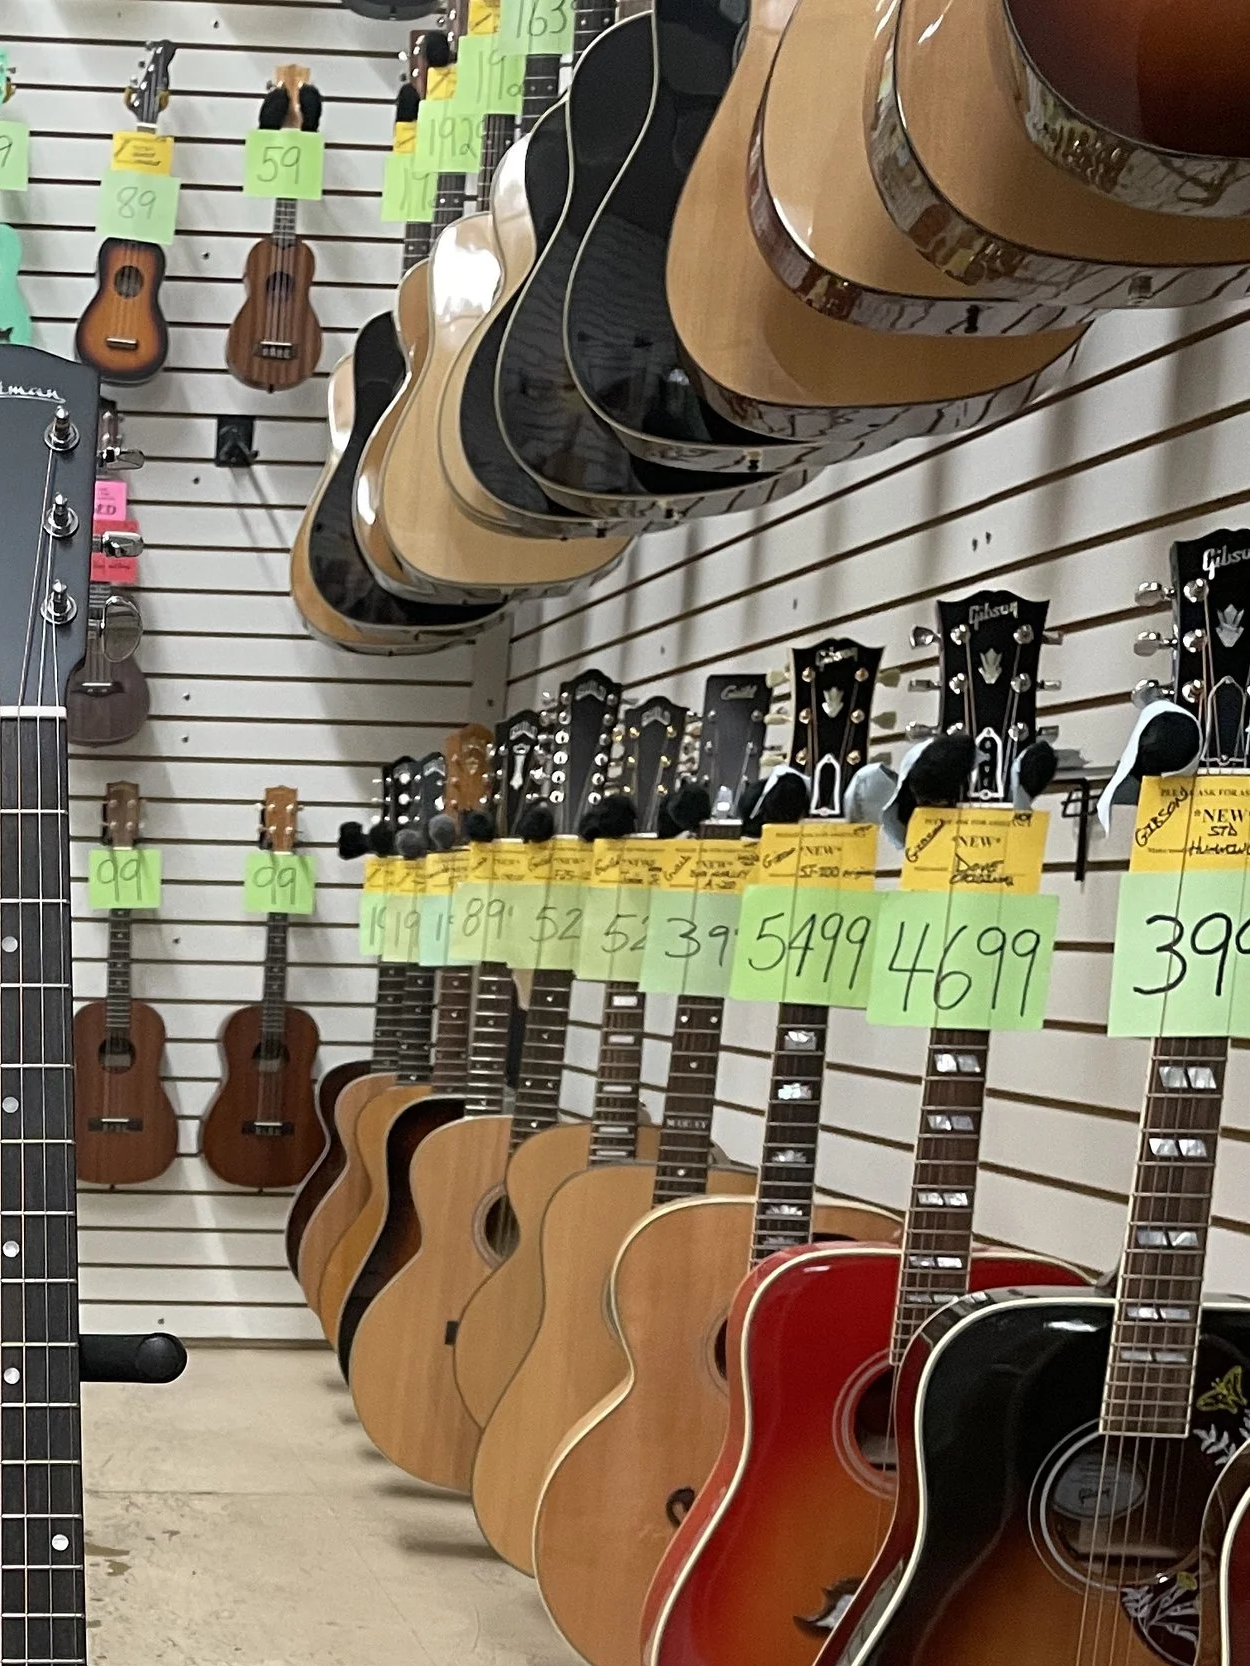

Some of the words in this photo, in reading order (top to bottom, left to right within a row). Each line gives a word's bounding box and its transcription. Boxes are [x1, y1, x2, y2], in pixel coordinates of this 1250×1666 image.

[256, 145, 302, 184] 59
[116, 186, 157, 219] 89
[969, 600, 1018, 631] Gibson
[1202, 808, 1244, 823] NEW
[97, 859, 142, 902] 99
[253, 866, 297, 905] 99
[462, 898, 514, 940] 89
[664, 917, 739, 967] 39
[748, 911, 872, 991] 5499
[887, 920, 1041, 1017] 4699
